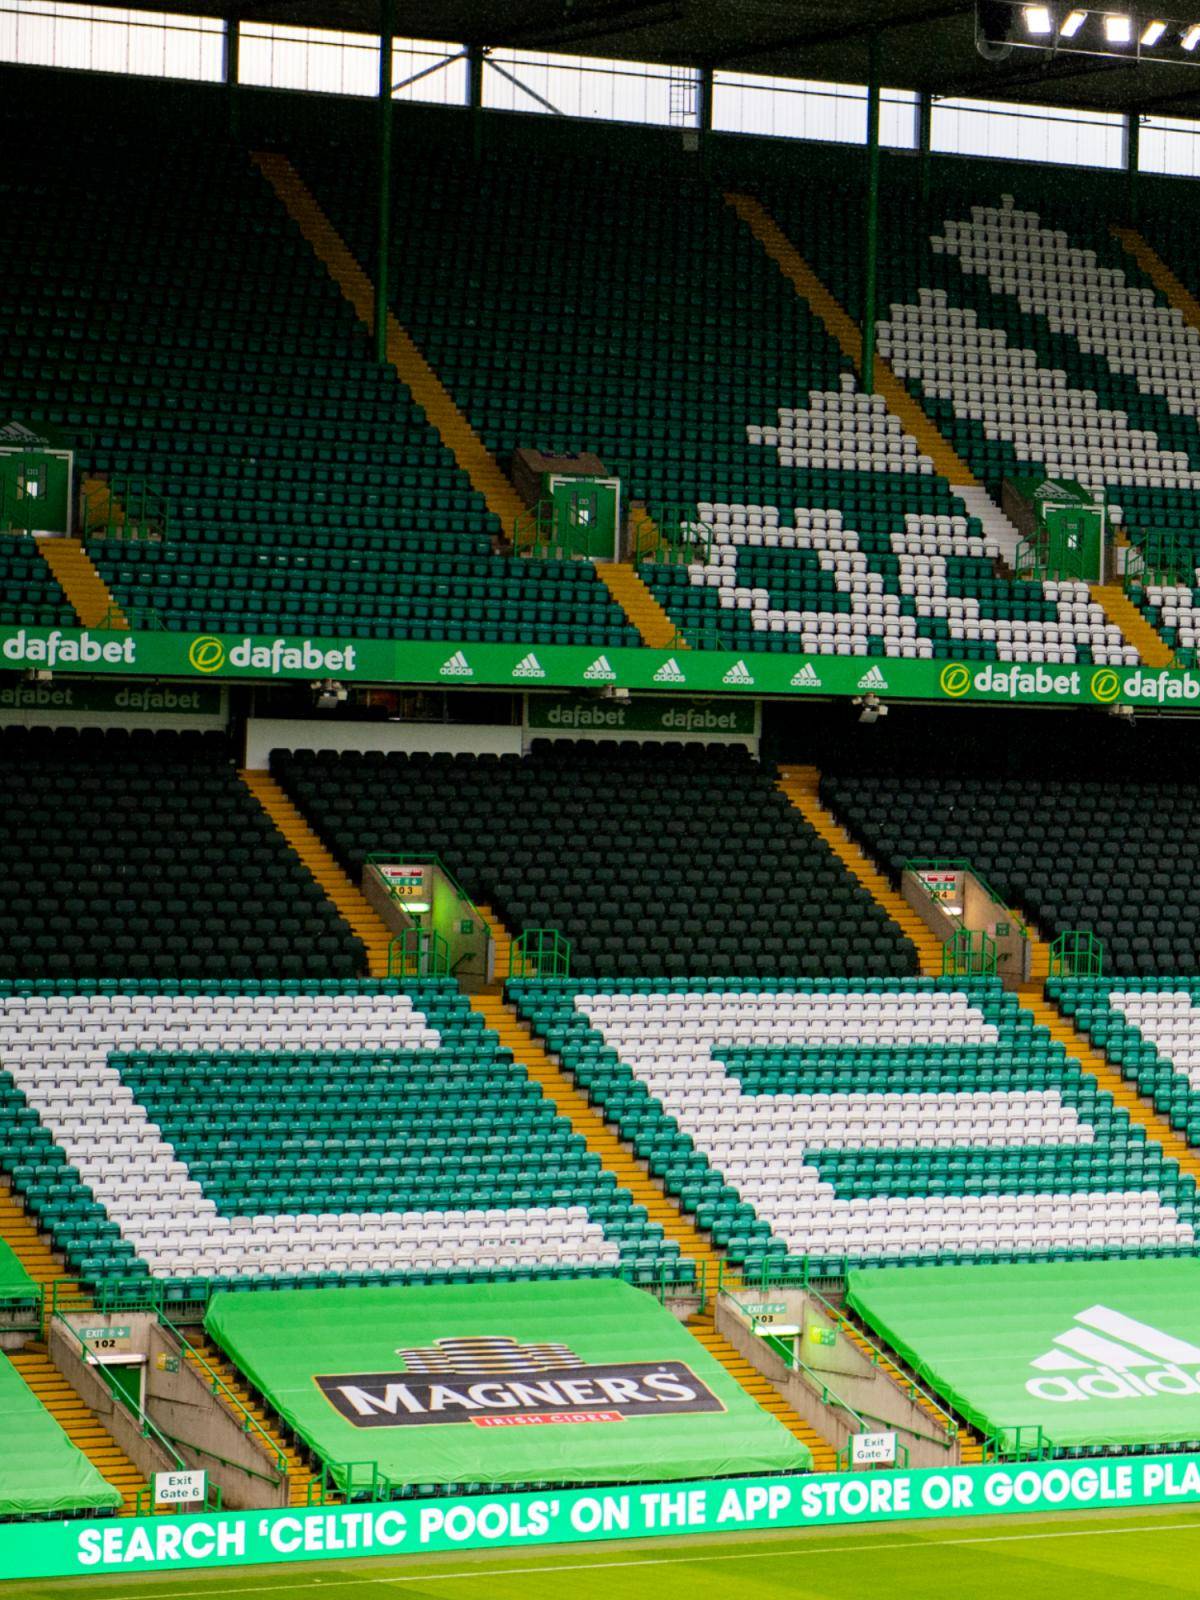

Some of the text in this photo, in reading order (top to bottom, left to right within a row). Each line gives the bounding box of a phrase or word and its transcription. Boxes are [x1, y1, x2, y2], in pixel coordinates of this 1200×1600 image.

[2, 630, 136, 667] dafabet
[229, 638, 356, 674] dafabet
[439, 665, 474, 677] adidas
[512, 667, 546, 679] adidas
[583, 669, 617, 680] adidas
[653, 671, 686, 683] adidas
[722, 674, 754, 685] adidas
[790, 676, 822, 688] adidas
[857, 679, 888, 690] adidas
[974, 665, 1080, 698] dafabet
[0, 685, 73, 706] afabet
[115, 688, 201, 712] dafabet
[548, 705, 626, 728] dafabet
[661, 708, 737, 731] dafabet
[85, 1329, 104, 1338] EXIT
[95, 1340, 116, 1348] 102
[337, 1371, 698, 1416] MAGNERS
[485, 1413, 614, 1426] IRISH CIDER
[864, 1439, 884, 1447] Exit
[857, 1449, 891, 1459] Gate 7
[168, 1476, 192, 1486] Exit
[160, 1488, 200, 1499] Gate 6
[77, 1520, 245, 1565] SEARCH
[570, 1499, 630, 1533] ON
[640, 1490, 706, 1529] THE
[716, 1485, 792, 1524] APP
[801, 1477, 910, 1518] STORE
[921, 1474, 974, 1510] OR
[984, 1465, 1132, 1506] GOOGLE
